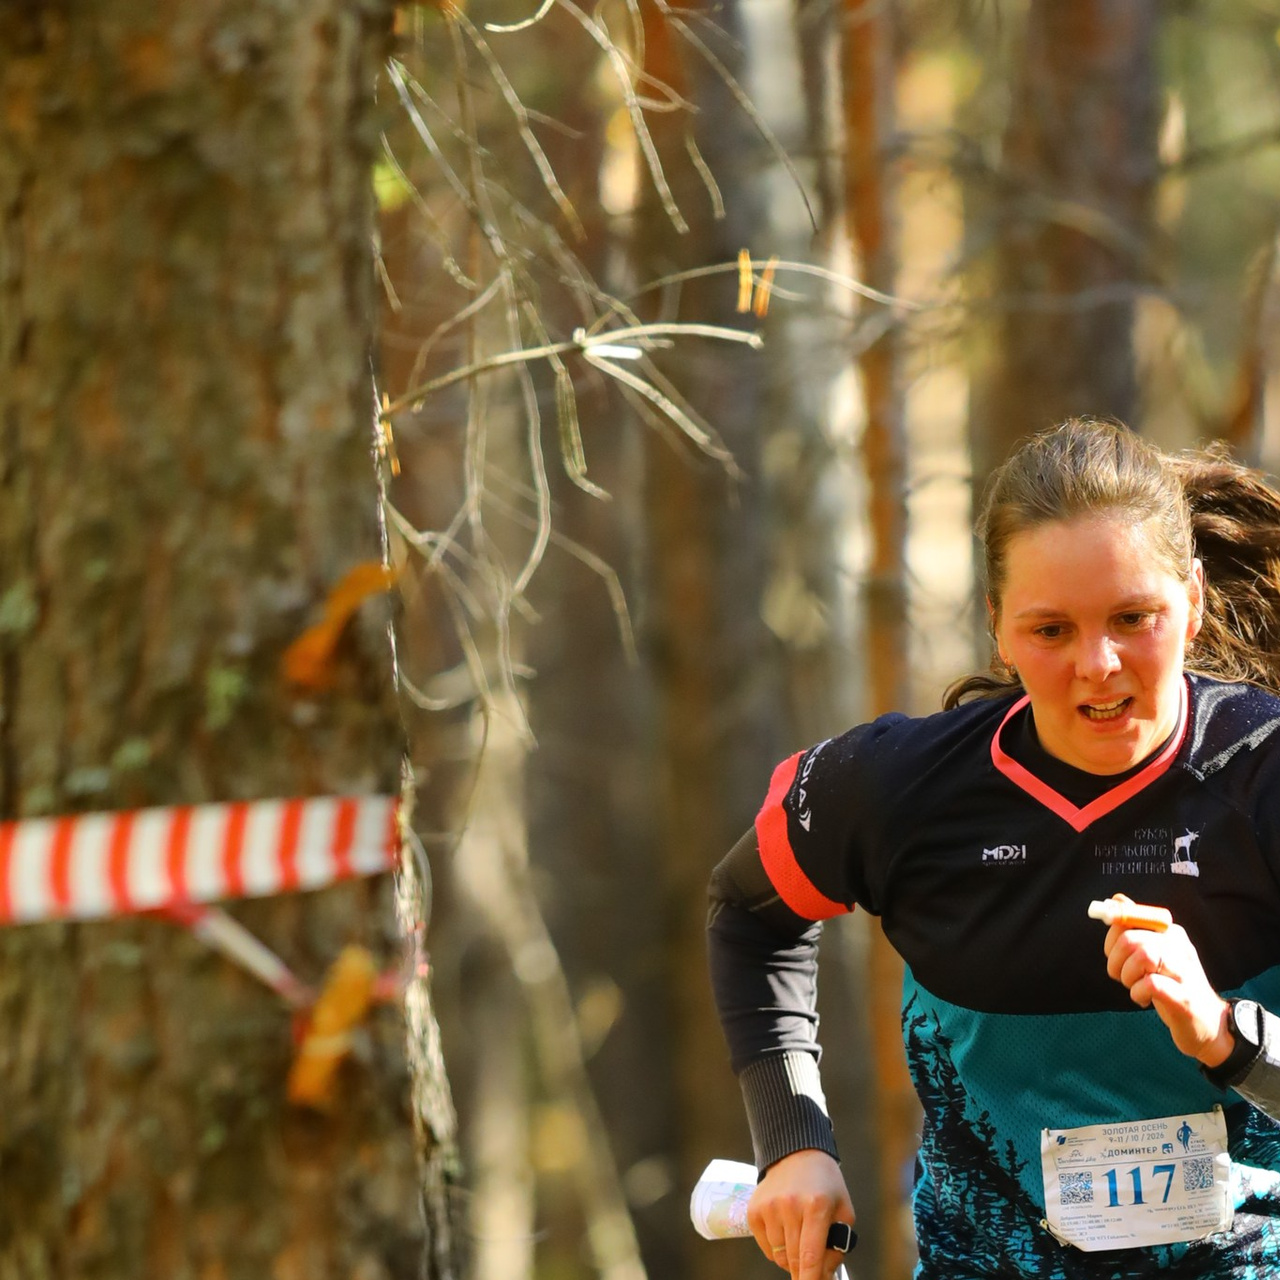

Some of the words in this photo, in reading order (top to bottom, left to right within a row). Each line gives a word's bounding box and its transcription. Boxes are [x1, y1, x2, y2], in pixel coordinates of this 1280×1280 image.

[1102, 1125, 1139, 1136] ЗОЛОТАЯ
[1141, 1122, 1168, 1132] ОСЕНЬ
[1131, 1134, 1139, 1142] 10
[1107, 1146, 1158, 1158] ДОМИНТЕР
[1101, 1163, 1177, 1209] 117
